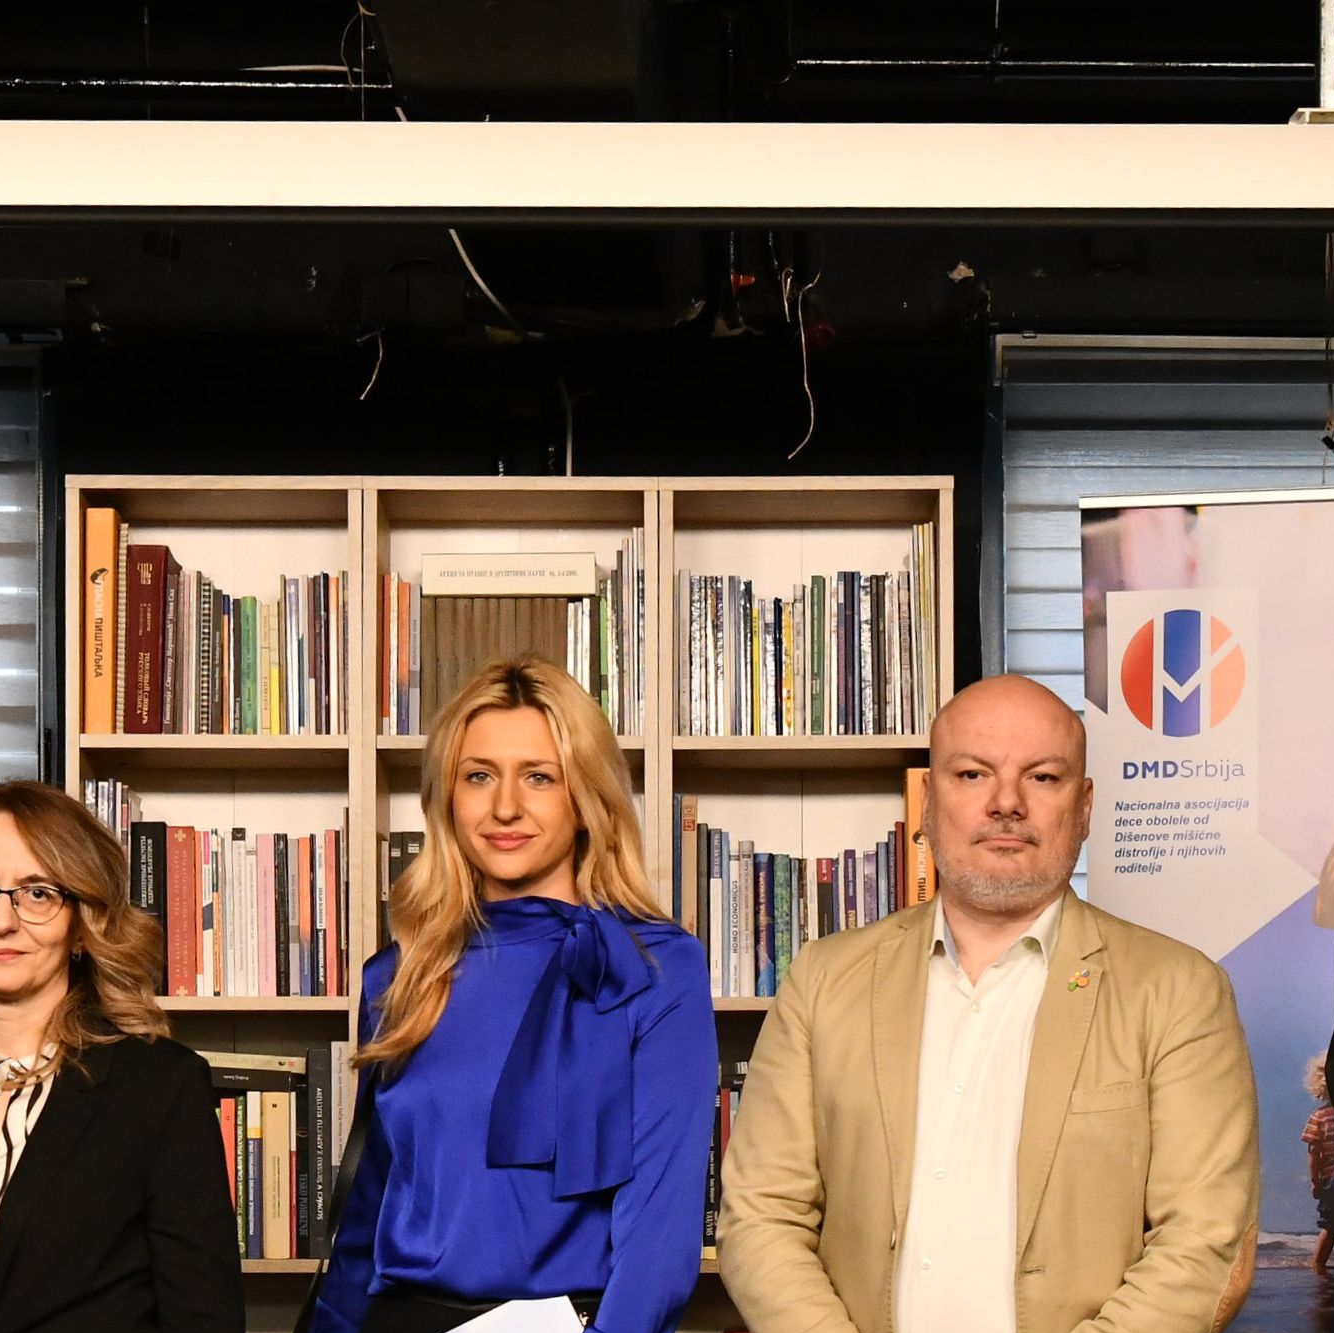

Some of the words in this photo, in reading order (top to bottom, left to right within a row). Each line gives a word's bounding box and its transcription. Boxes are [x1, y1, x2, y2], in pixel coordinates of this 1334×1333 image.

[1122, 759, 1245, 782] DMDSrbija
[1114, 800, 1181, 812] Nacionalna
[1184, 798, 1250, 812] asocijacija
[1114, 816, 1143, 827] dece
[1146, 815, 1190, 826] obolele
[1193, 814, 1210, 825] od
[1114, 831, 1170, 843] Dišenove
[1114, 846, 1167, 859] distrofije
[1169, 846, 1174, 857] i
[1177, 845, 1226, 859] njihovih
[1114, 862, 1162, 875] roditelja
